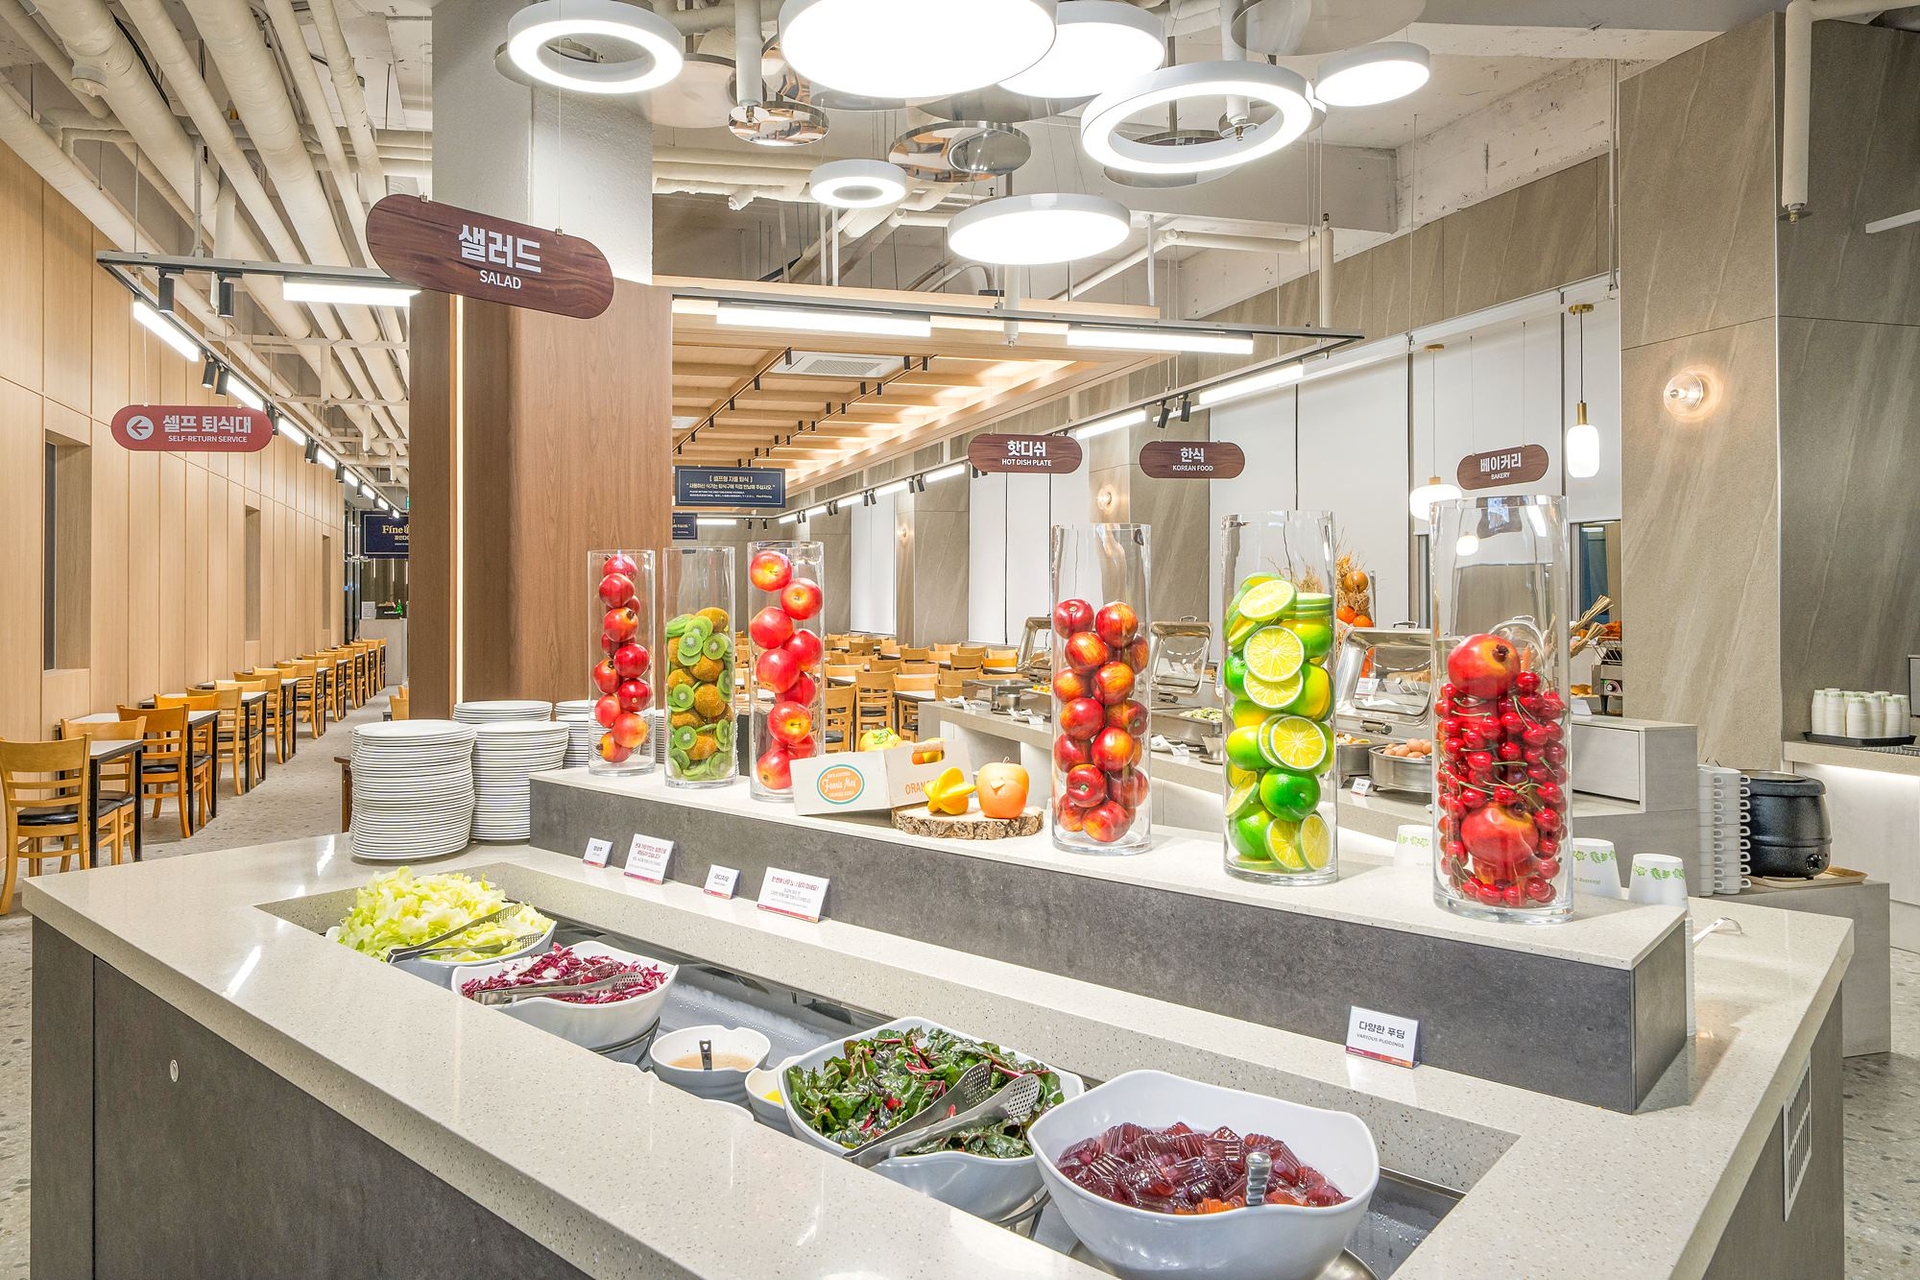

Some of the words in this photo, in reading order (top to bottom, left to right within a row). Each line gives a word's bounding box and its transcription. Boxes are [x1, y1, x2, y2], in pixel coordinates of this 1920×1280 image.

[459, 224, 541, 273] 샐러드
[480, 269, 522, 290] SALAD
[163, 415, 198, 433] 셀프
[202, 416, 251, 433] 퇴식대
[168, 435, 217, 443] SELF-RETURN
[1007, 440, 1046, 457] 핫디쉬
[1180, 447, 1205, 463] 한식
[1032, 459, 1052, 467] PLATE
[1172, 464, 1196, 472] KOREAN
[1480, 452, 1521, 472] 베이커리
[1491, 472, 1510, 480] BAKERY
[1359, 1021, 1385, 1034] 다양한
[1388, 1027, 1406, 1040] 푸딩
[1356, 1033, 1378, 1042] VARIOUS
[1378, 1038, 1405, 1048] PUDDINGS
